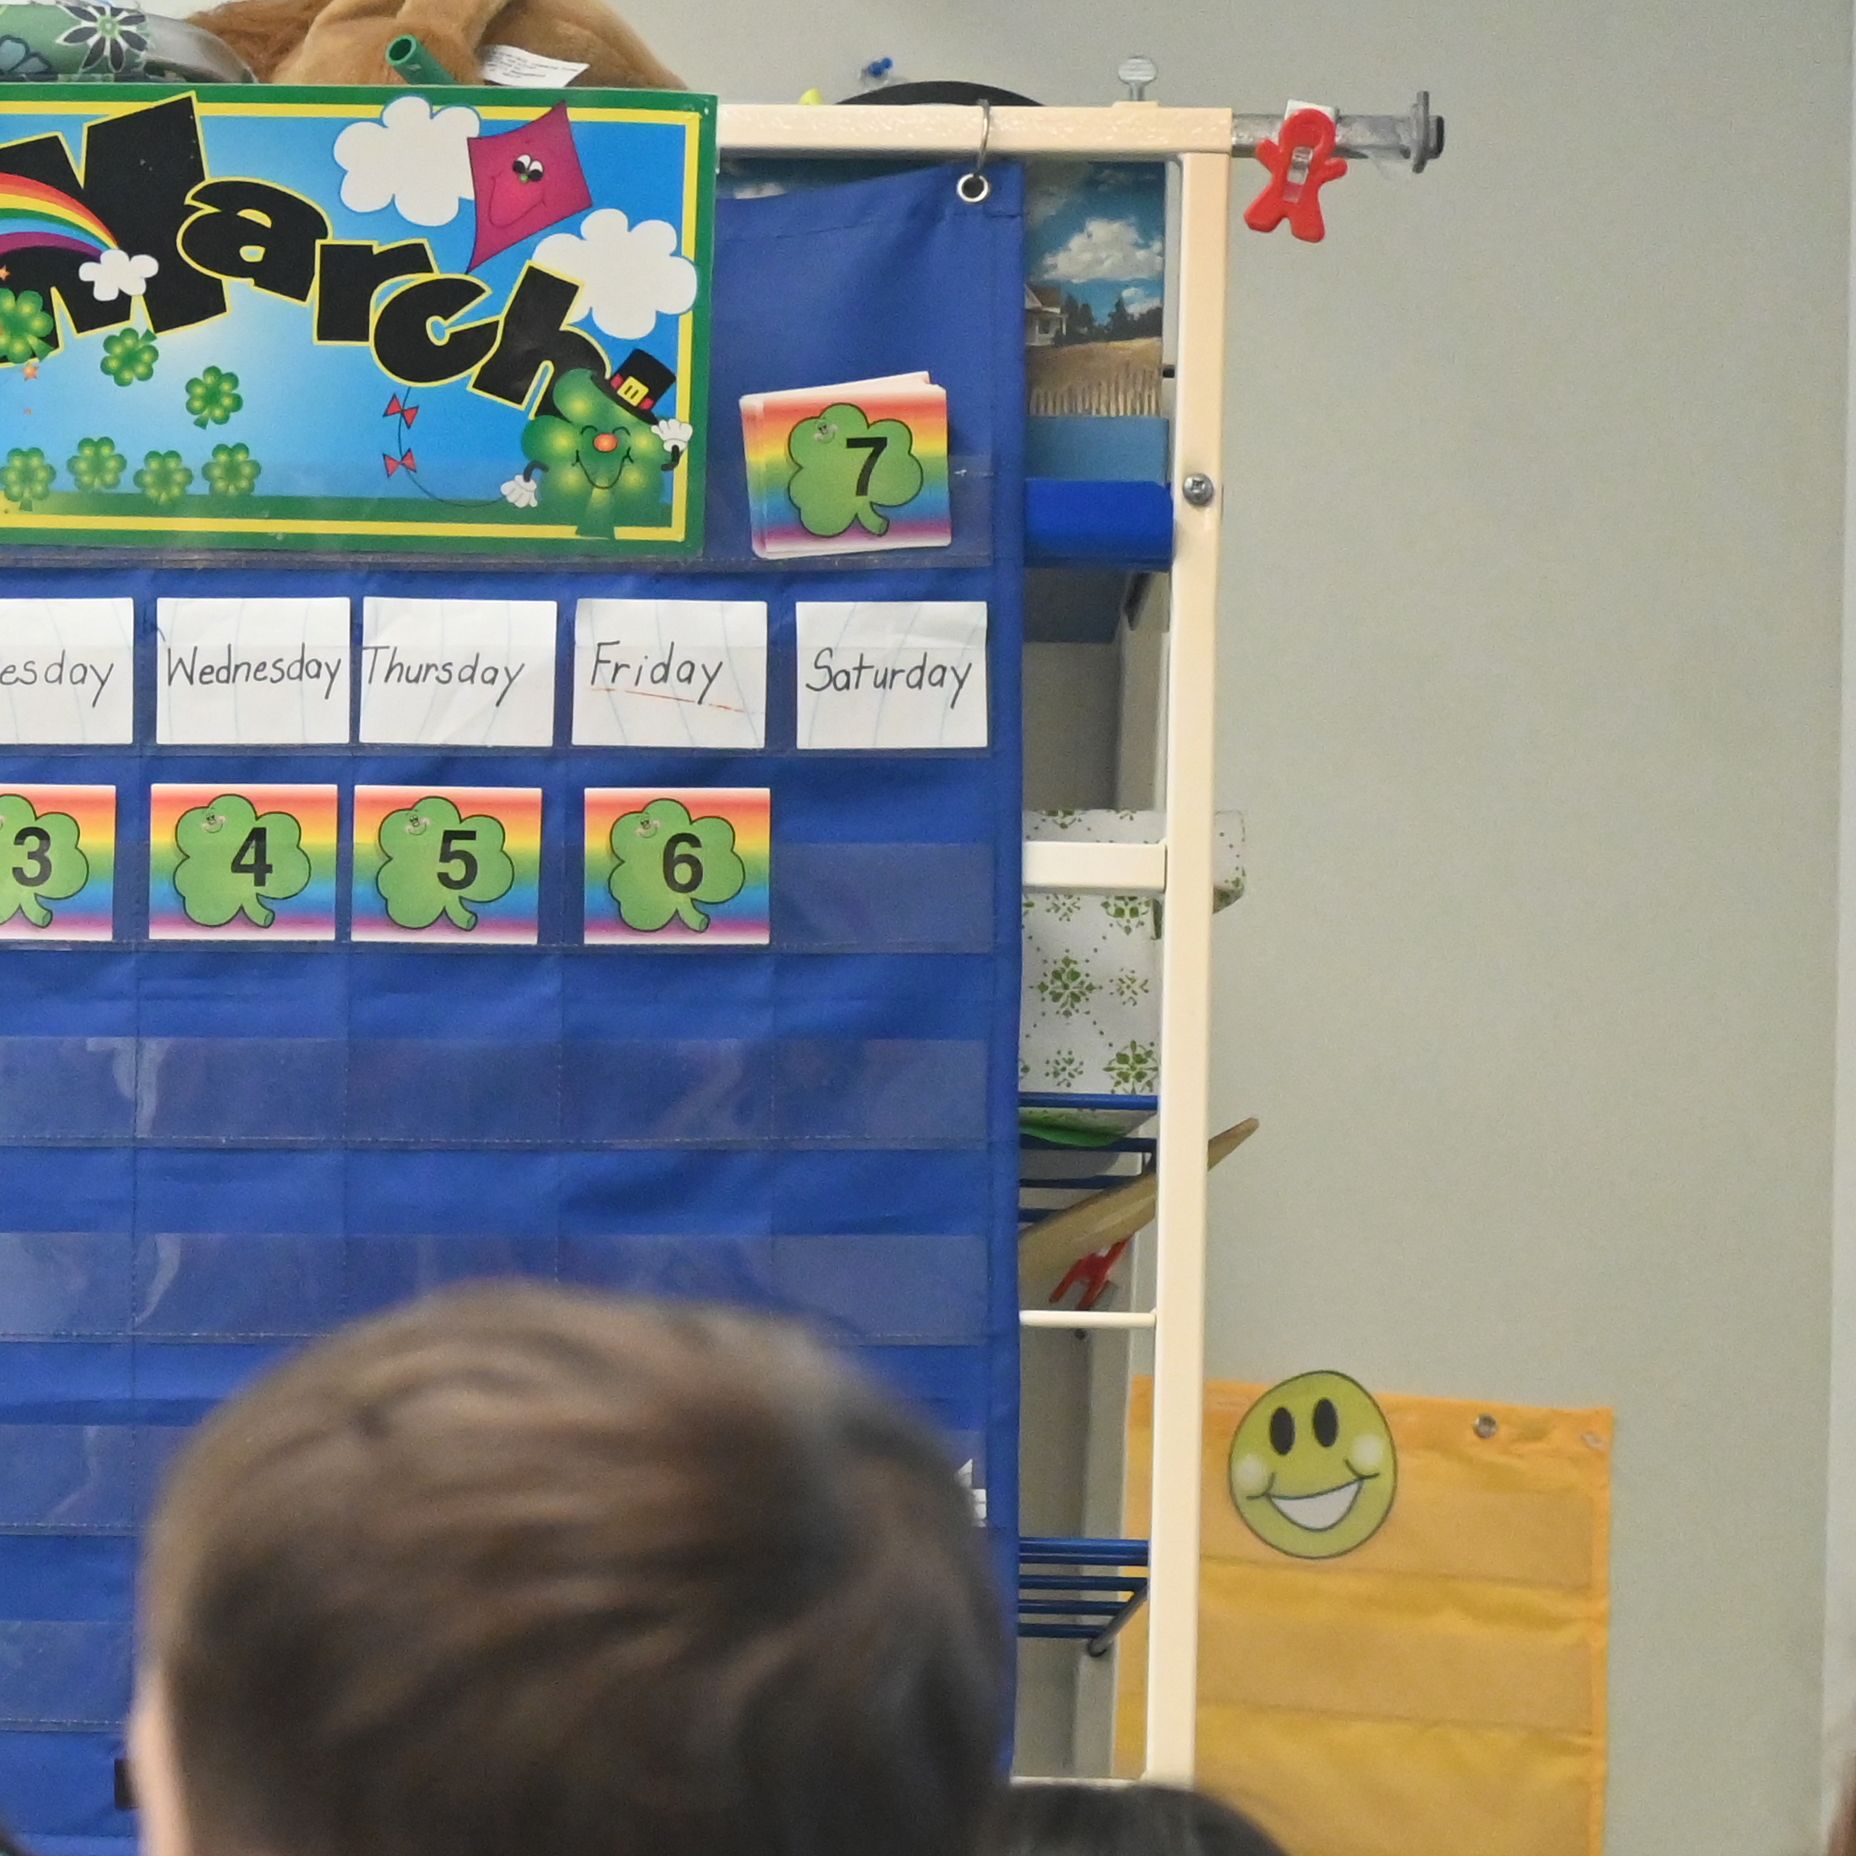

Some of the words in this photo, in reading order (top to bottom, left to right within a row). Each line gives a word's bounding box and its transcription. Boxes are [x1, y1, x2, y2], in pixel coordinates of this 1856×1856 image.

[845, 436, 888, 496] 7
[166, 641, 343, 701] Wednesday
[361, 644, 526, 708] Thursday
[589, 639, 724, 706] Friday
[804, 645, 974, 710] Saturday
[12, 826, 52, 887] 3
[230, 827, 275, 887] 4
[436, 829, 479, 891] 5
[661, 831, 704, 894] 6
